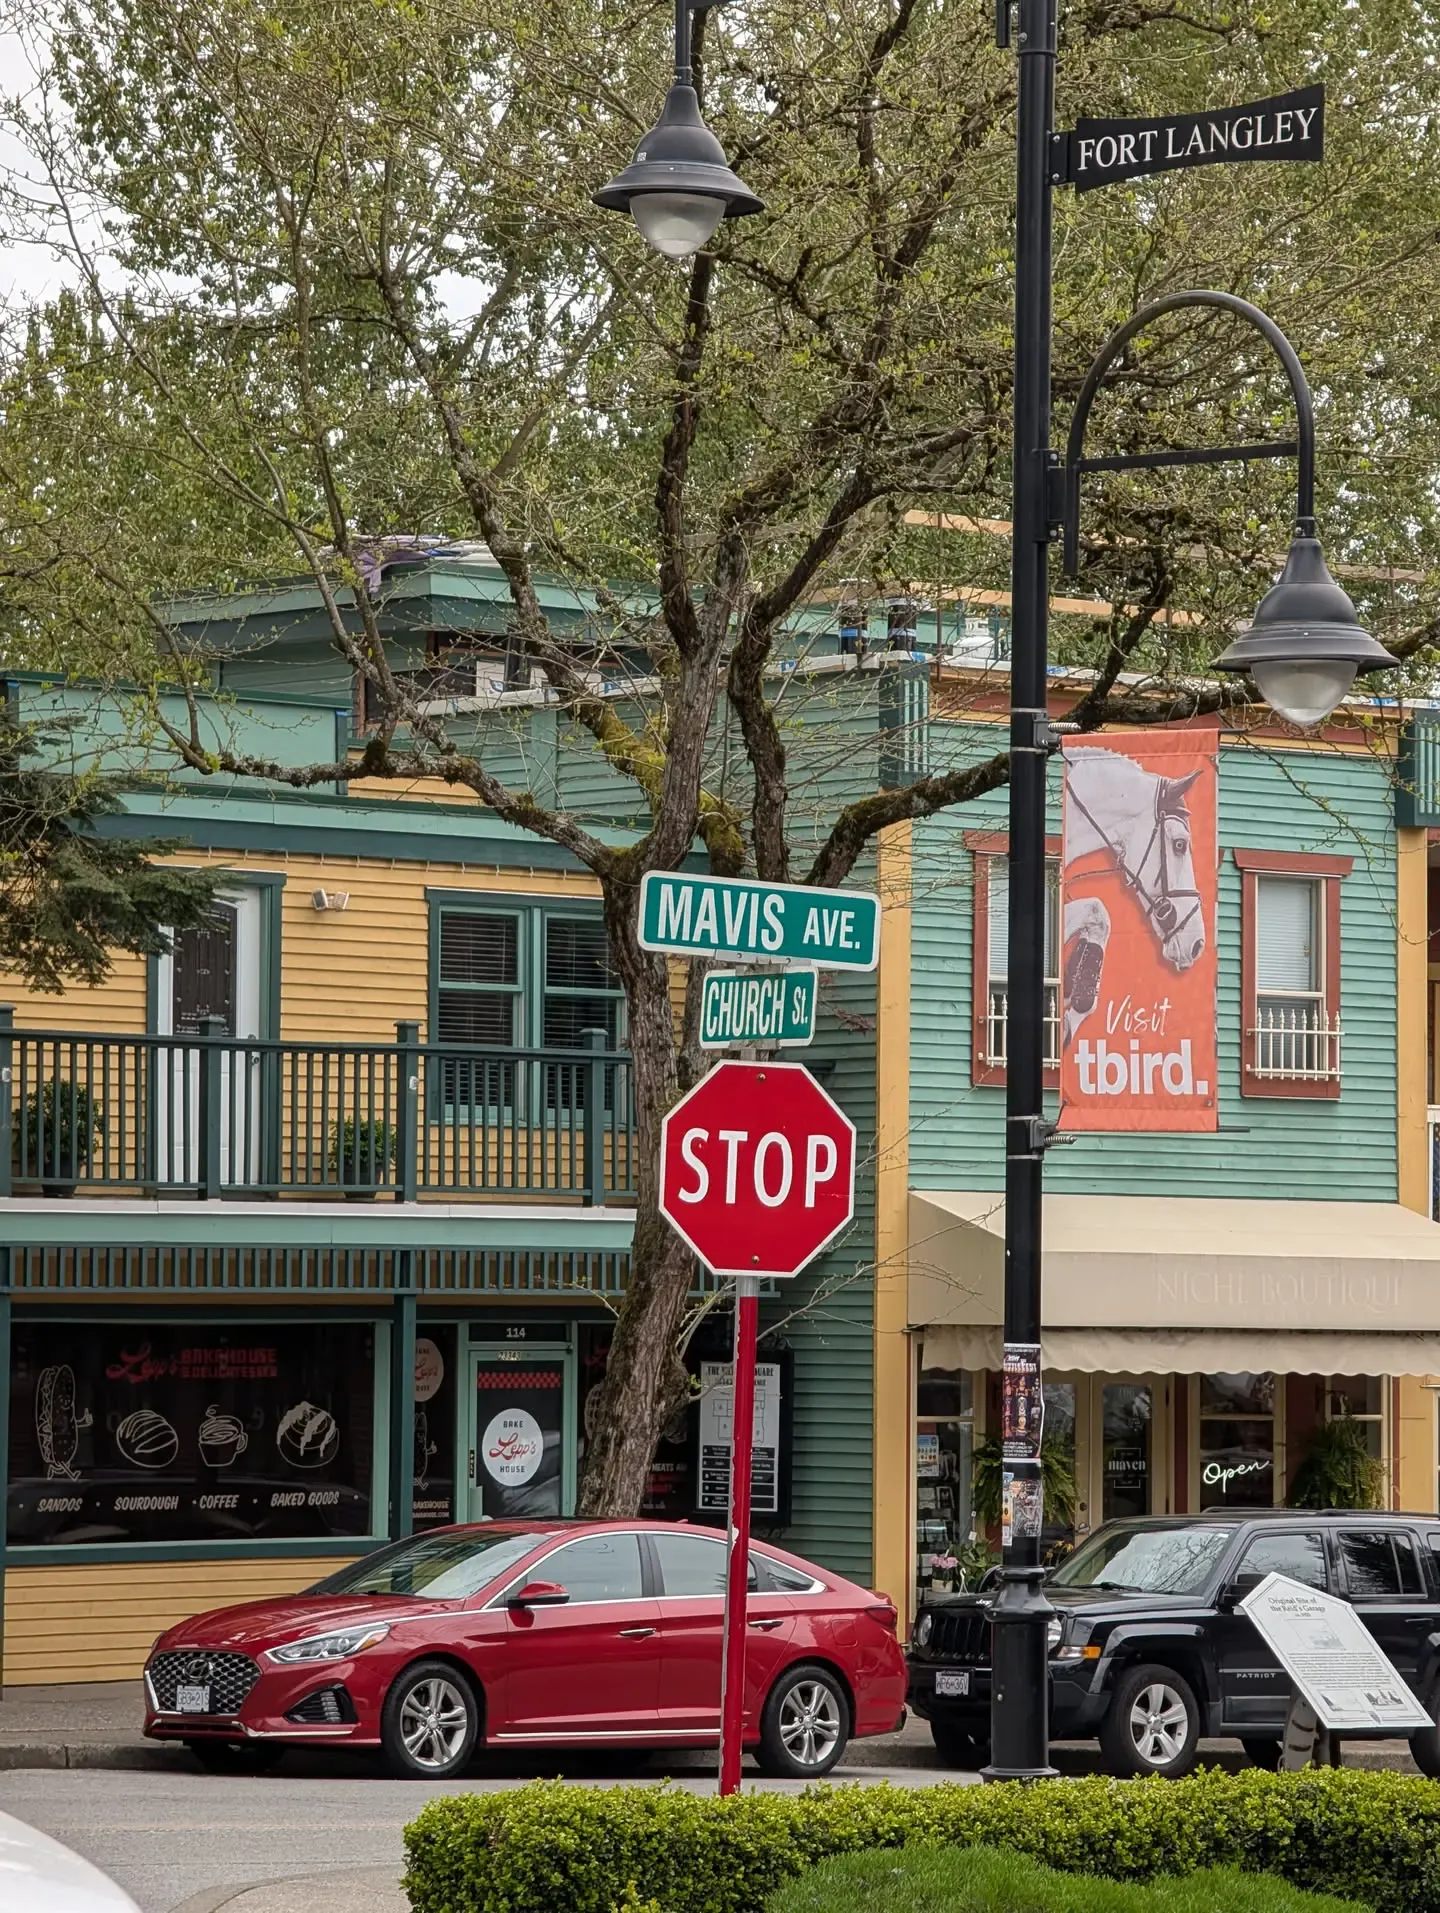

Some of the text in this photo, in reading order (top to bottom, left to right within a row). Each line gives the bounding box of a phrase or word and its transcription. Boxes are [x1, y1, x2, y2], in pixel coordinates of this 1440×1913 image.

[1077, 107, 1319, 171] FORT LANGLEY
[657, 883, 861, 951] MAVIS AVE.
[706, 978, 787, 1038] CHURCH
[1105, 994, 1172, 1036] Visit
[1073, 1038, 1209, 1096] tbird.
[677, 1127, 838, 1208] STOP
[505, 1327, 526, 1338] 114
[503, 1420, 524, 1428] BAKE
[489, 1432, 537, 1461] Lepp's
[500, 1465, 526, 1473] HOUSE
[1108, 1460, 1146, 1471] maven
[1202, 1460, 1270, 1494] Open
[37, 1491, 340, 1513] SANDOS SOURDOUGH COFFEE BAKED GOODS
